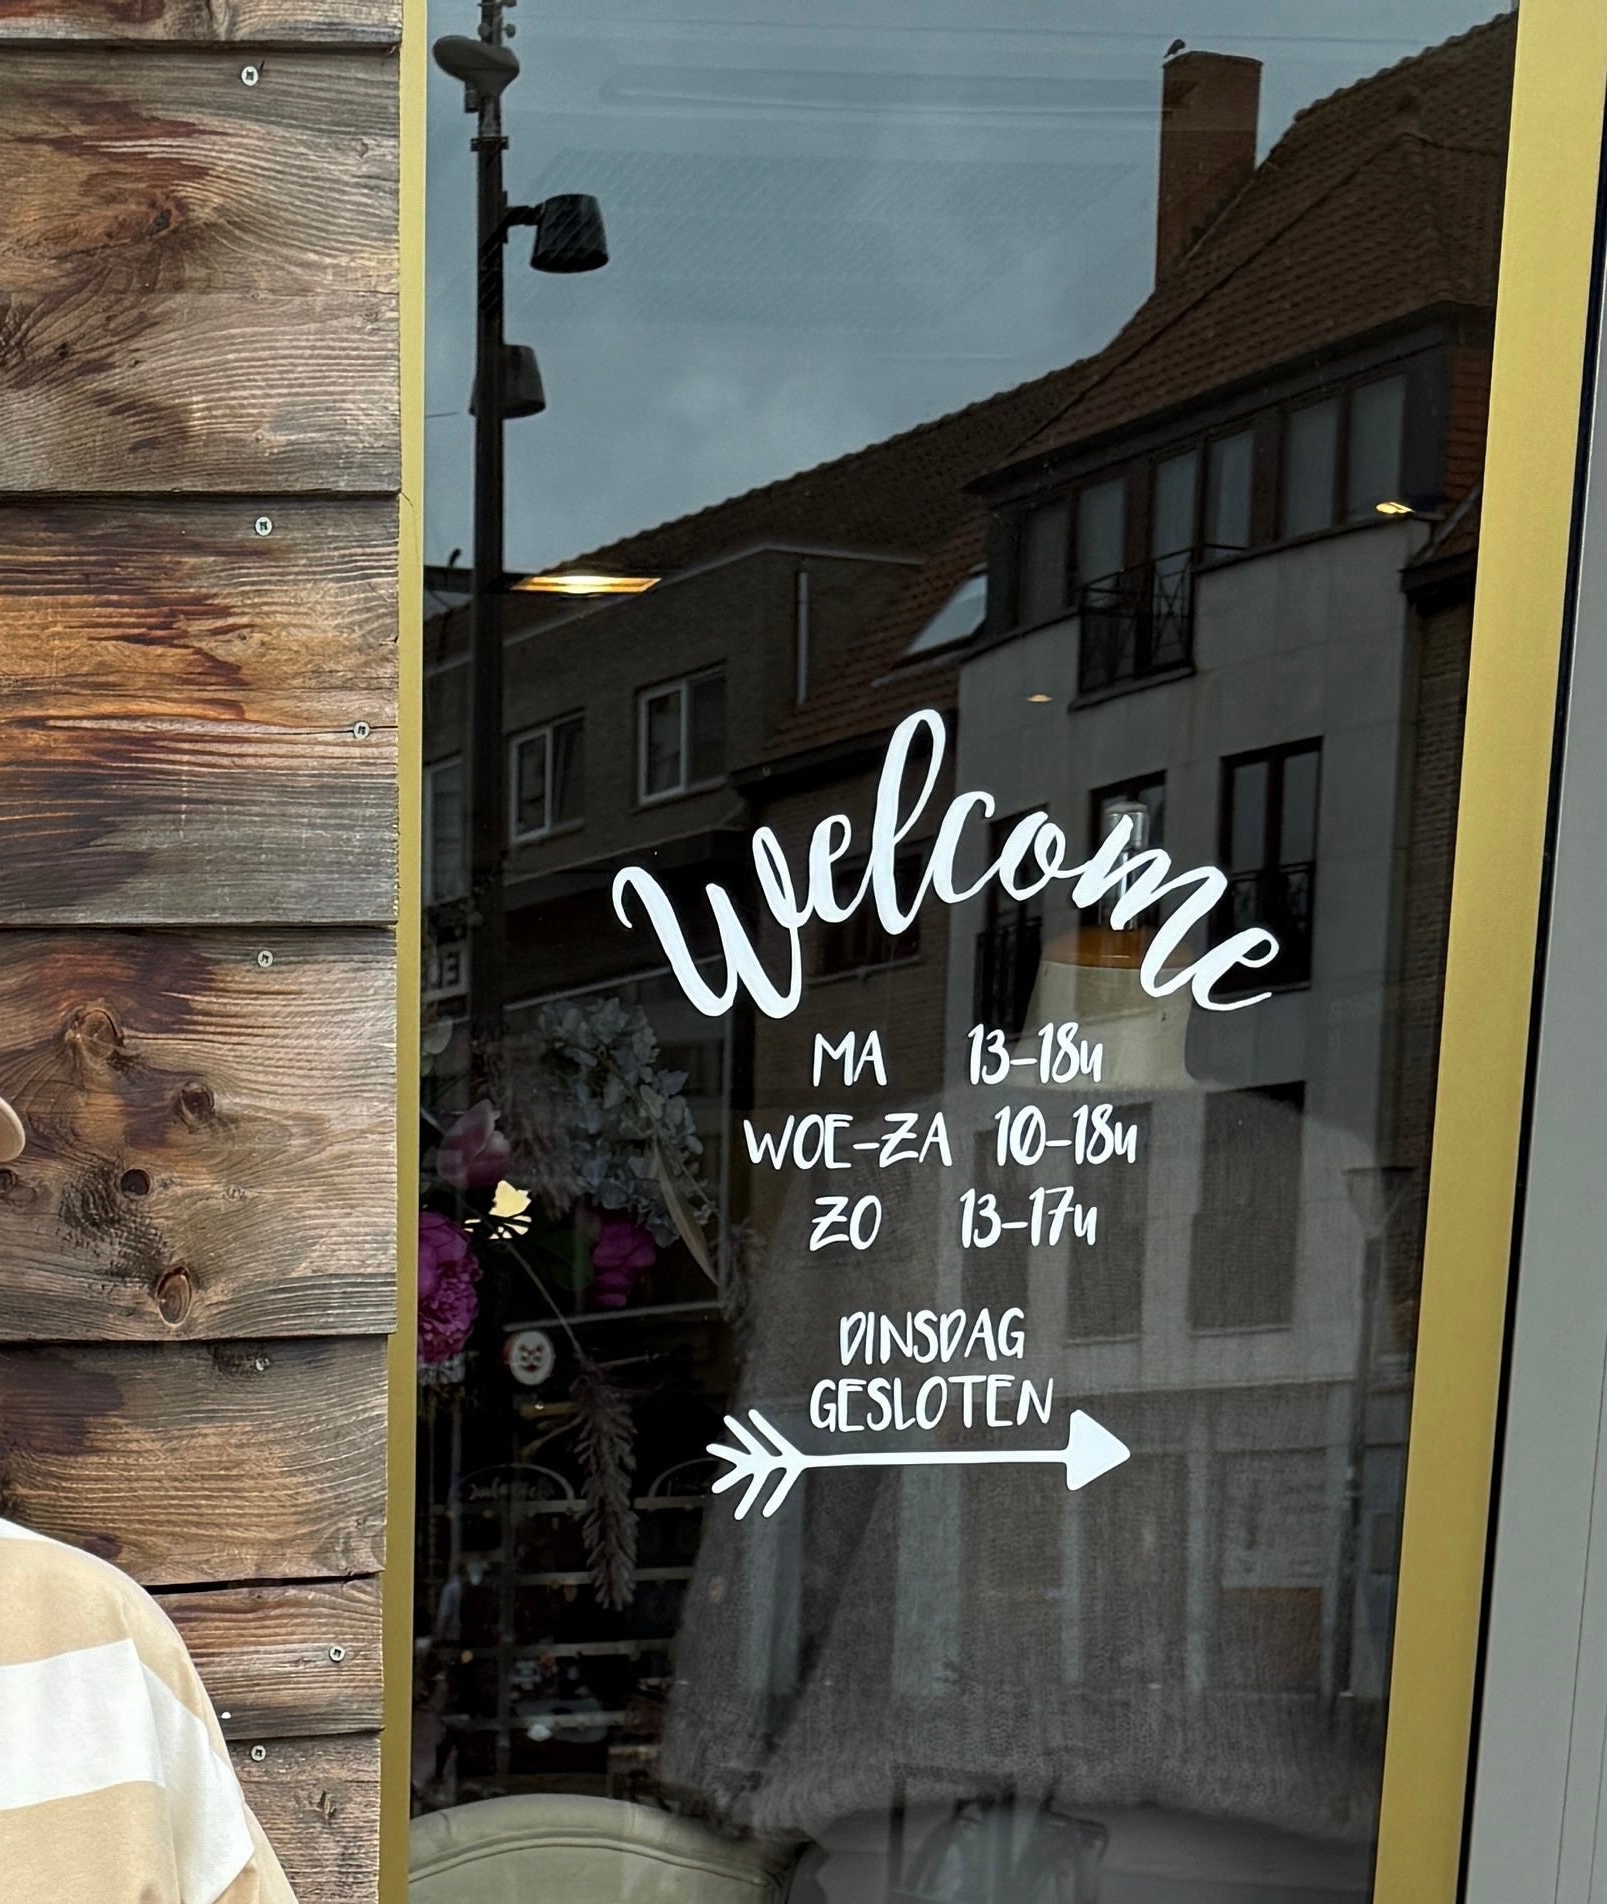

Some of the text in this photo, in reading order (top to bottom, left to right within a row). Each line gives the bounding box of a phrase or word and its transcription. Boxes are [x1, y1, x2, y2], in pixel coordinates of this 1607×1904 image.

[612, 709, 1280, 1019] Welcome
[813, 1021, 1104, 1087] MA 13-18u
[743, 1103, 1138, 1170] WOE-ZA 10-18u
[809, 1185, 1098, 1252] ZO 13-17u
[839, 1307, 1025, 1366] DINSDAG
[809, 1373, 1054, 1433] GESLOTEN
